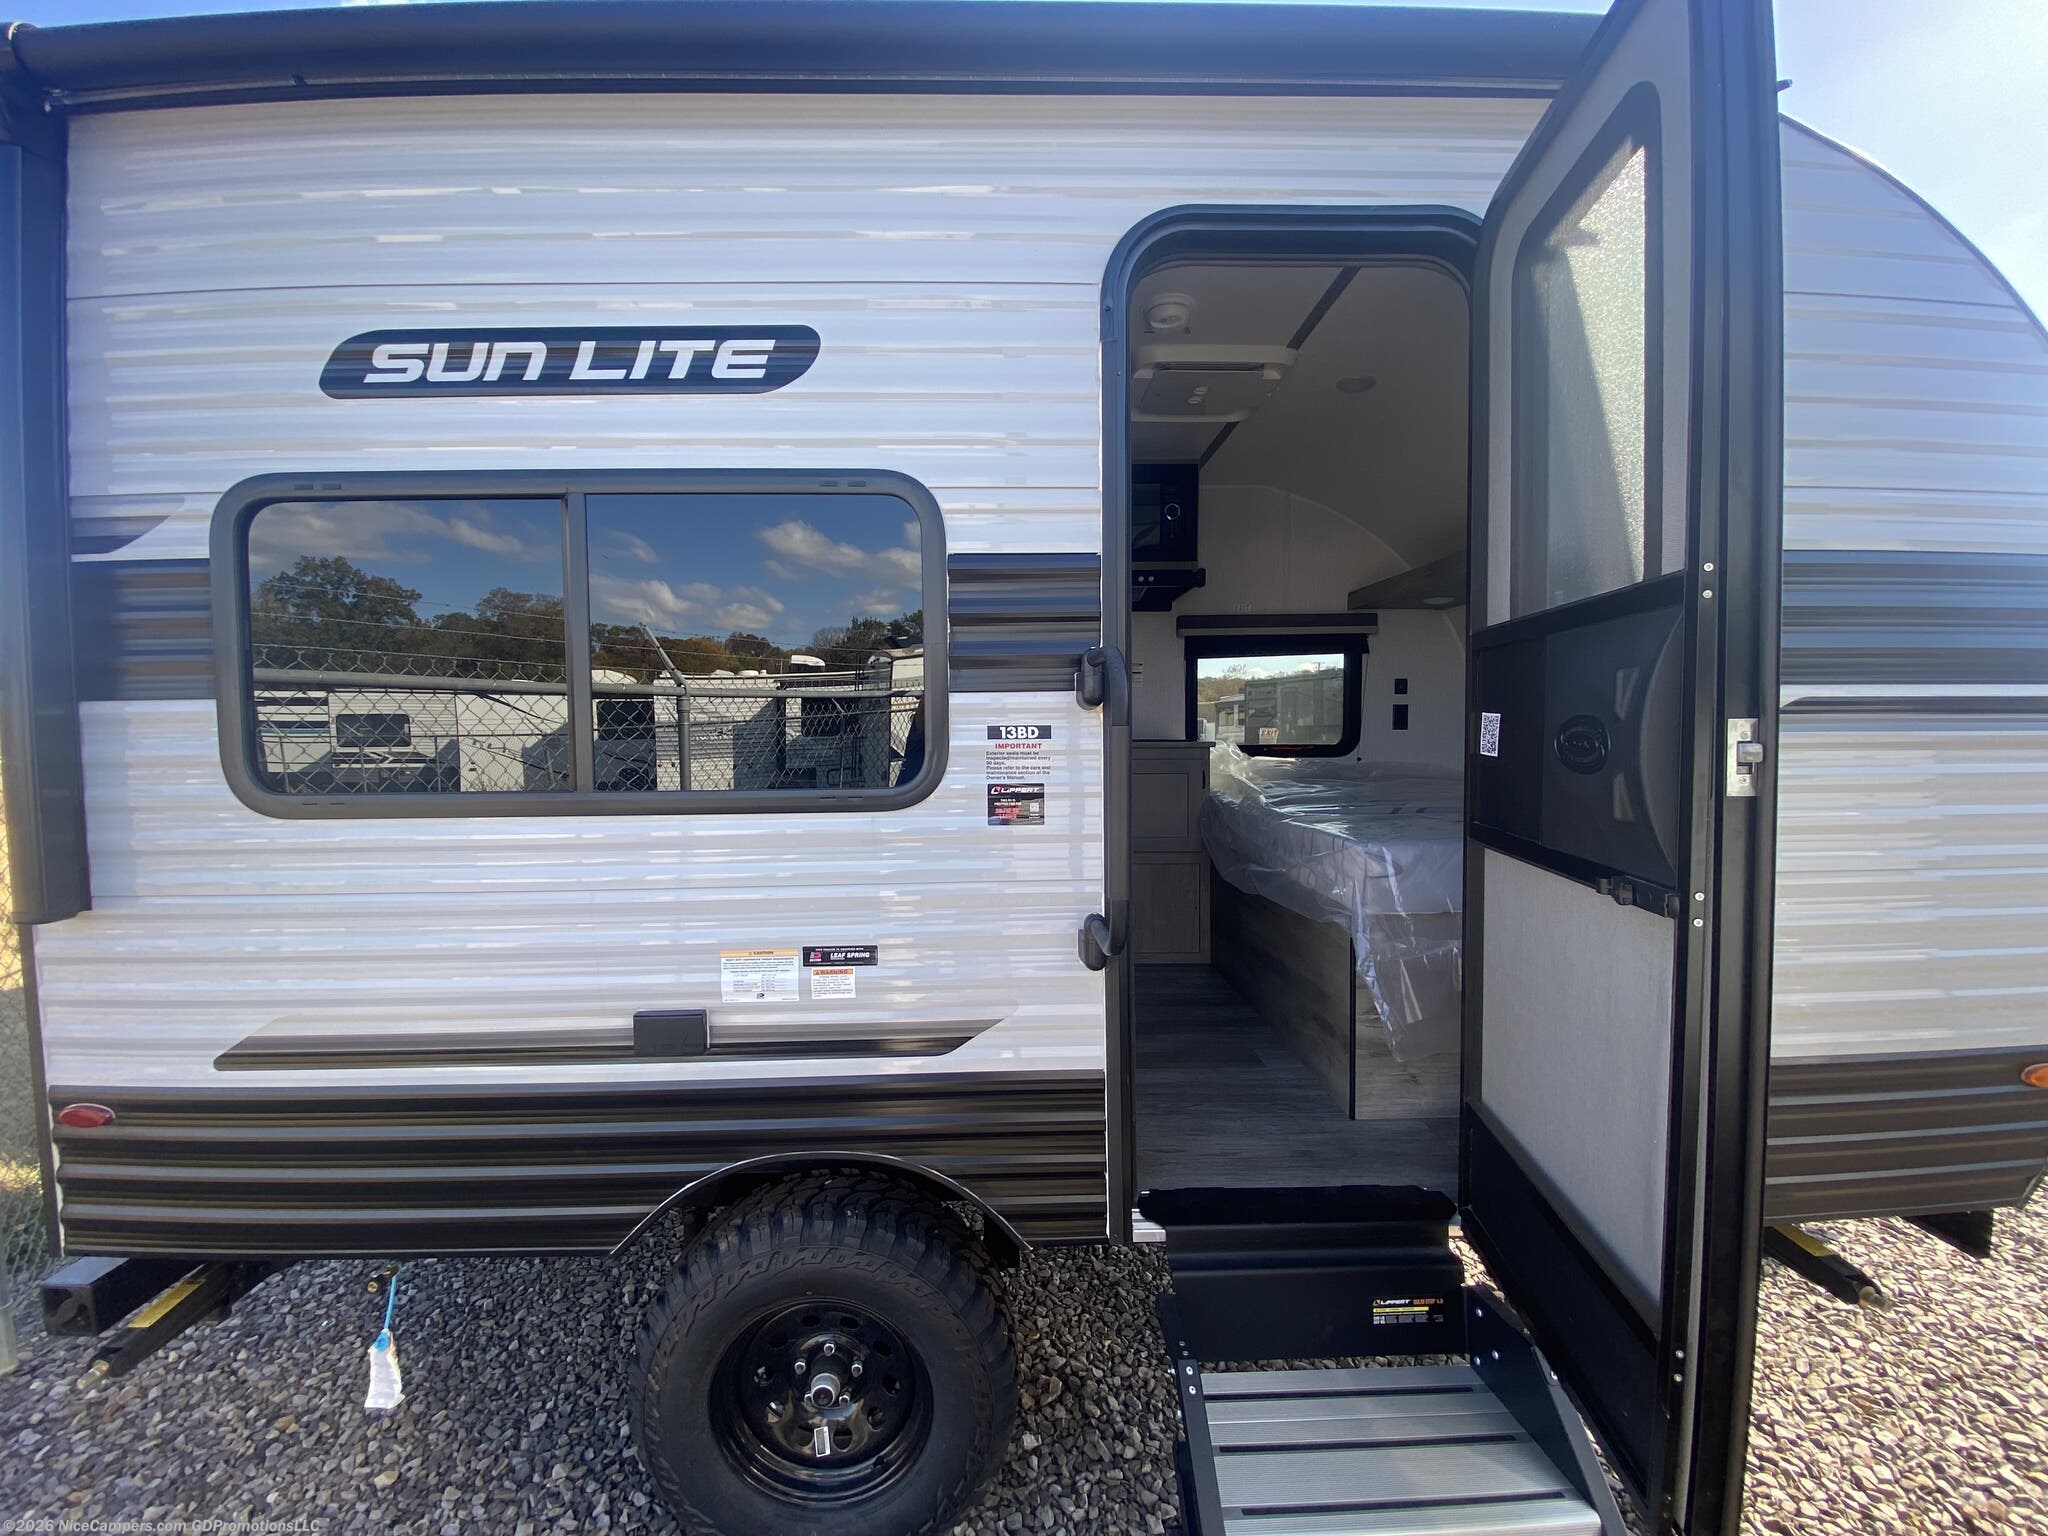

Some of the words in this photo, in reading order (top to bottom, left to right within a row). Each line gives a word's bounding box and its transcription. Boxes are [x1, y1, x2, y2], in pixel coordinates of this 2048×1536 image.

[363, 341, 547, 383] SUN
[568, 339, 776, 380] LITE
[1000, 726, 1039, 739] 13BD
